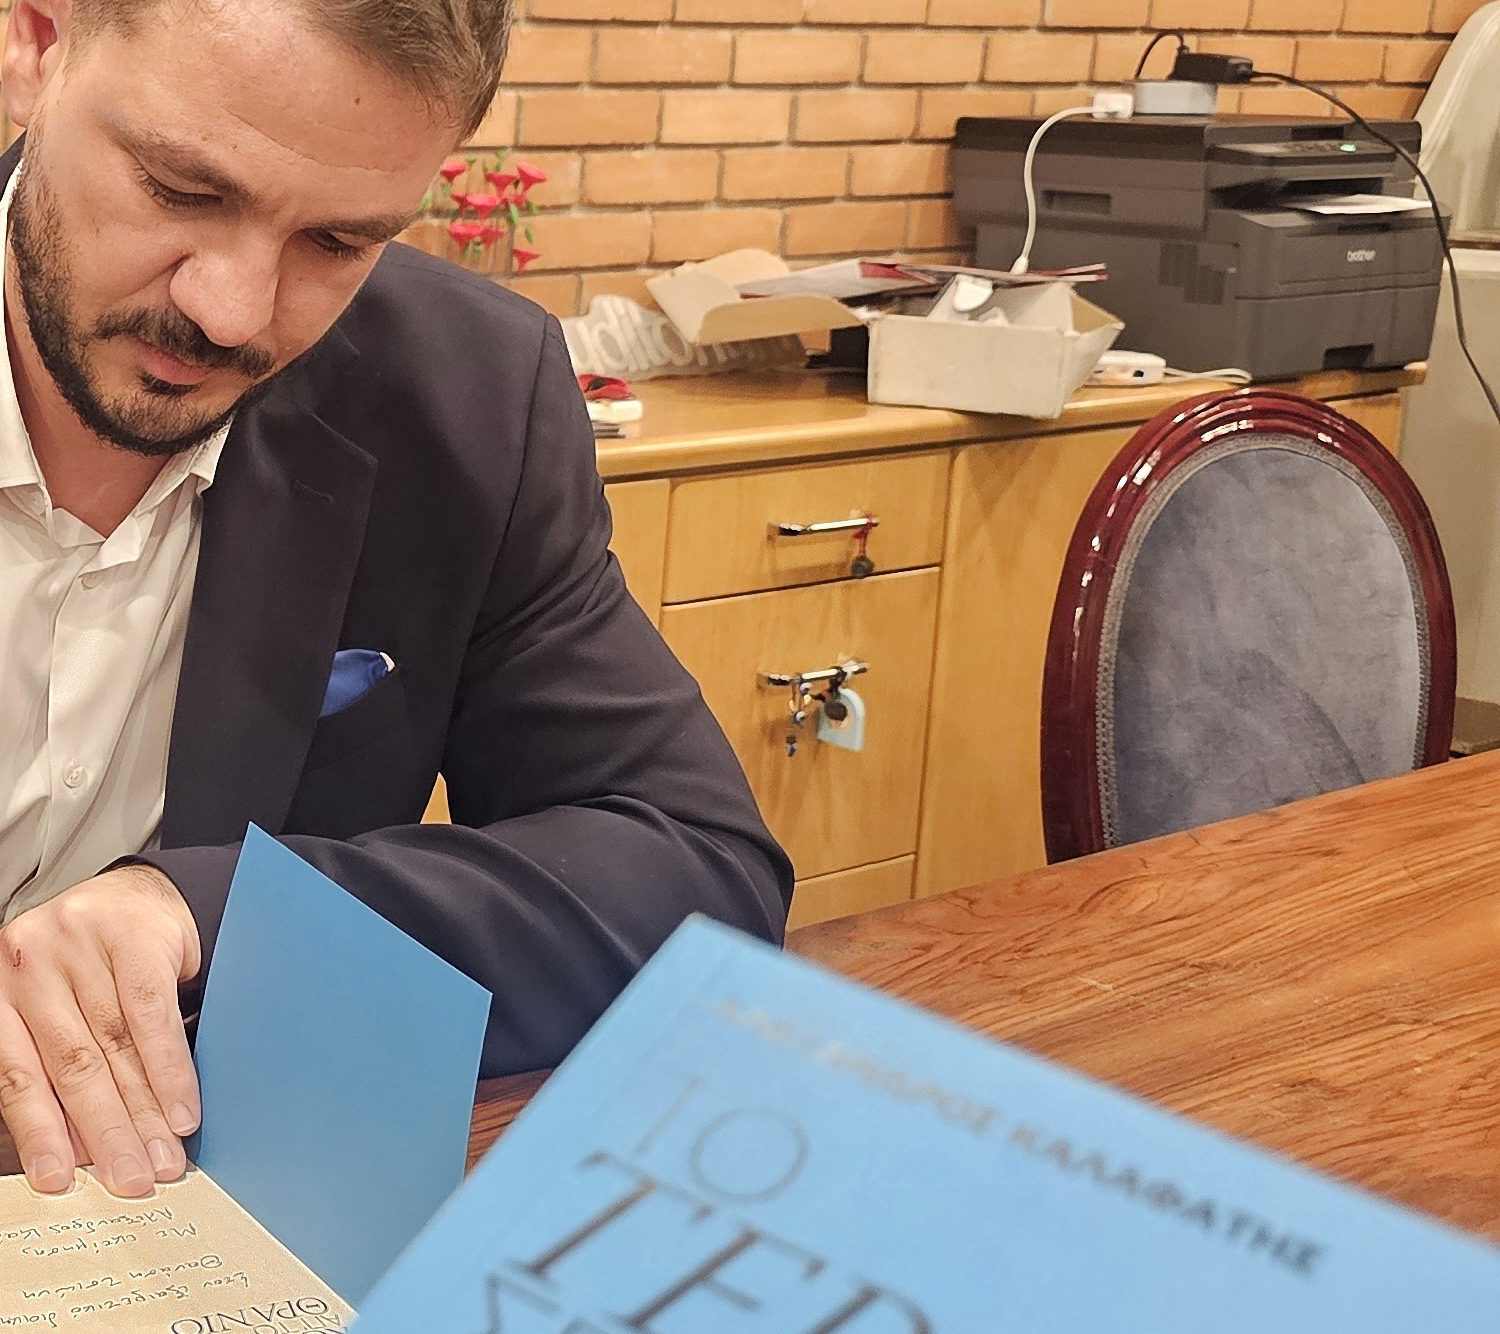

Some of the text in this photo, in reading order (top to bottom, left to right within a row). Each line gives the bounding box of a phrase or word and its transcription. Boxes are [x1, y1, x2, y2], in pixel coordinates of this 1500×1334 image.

[628, 1065, 810, 1207] ΤΟ
[1010, 1122, 1328, 1283] ΚΑΛΑΦΑΤΗΣ
[156, 1222, 197, 1237] Με
